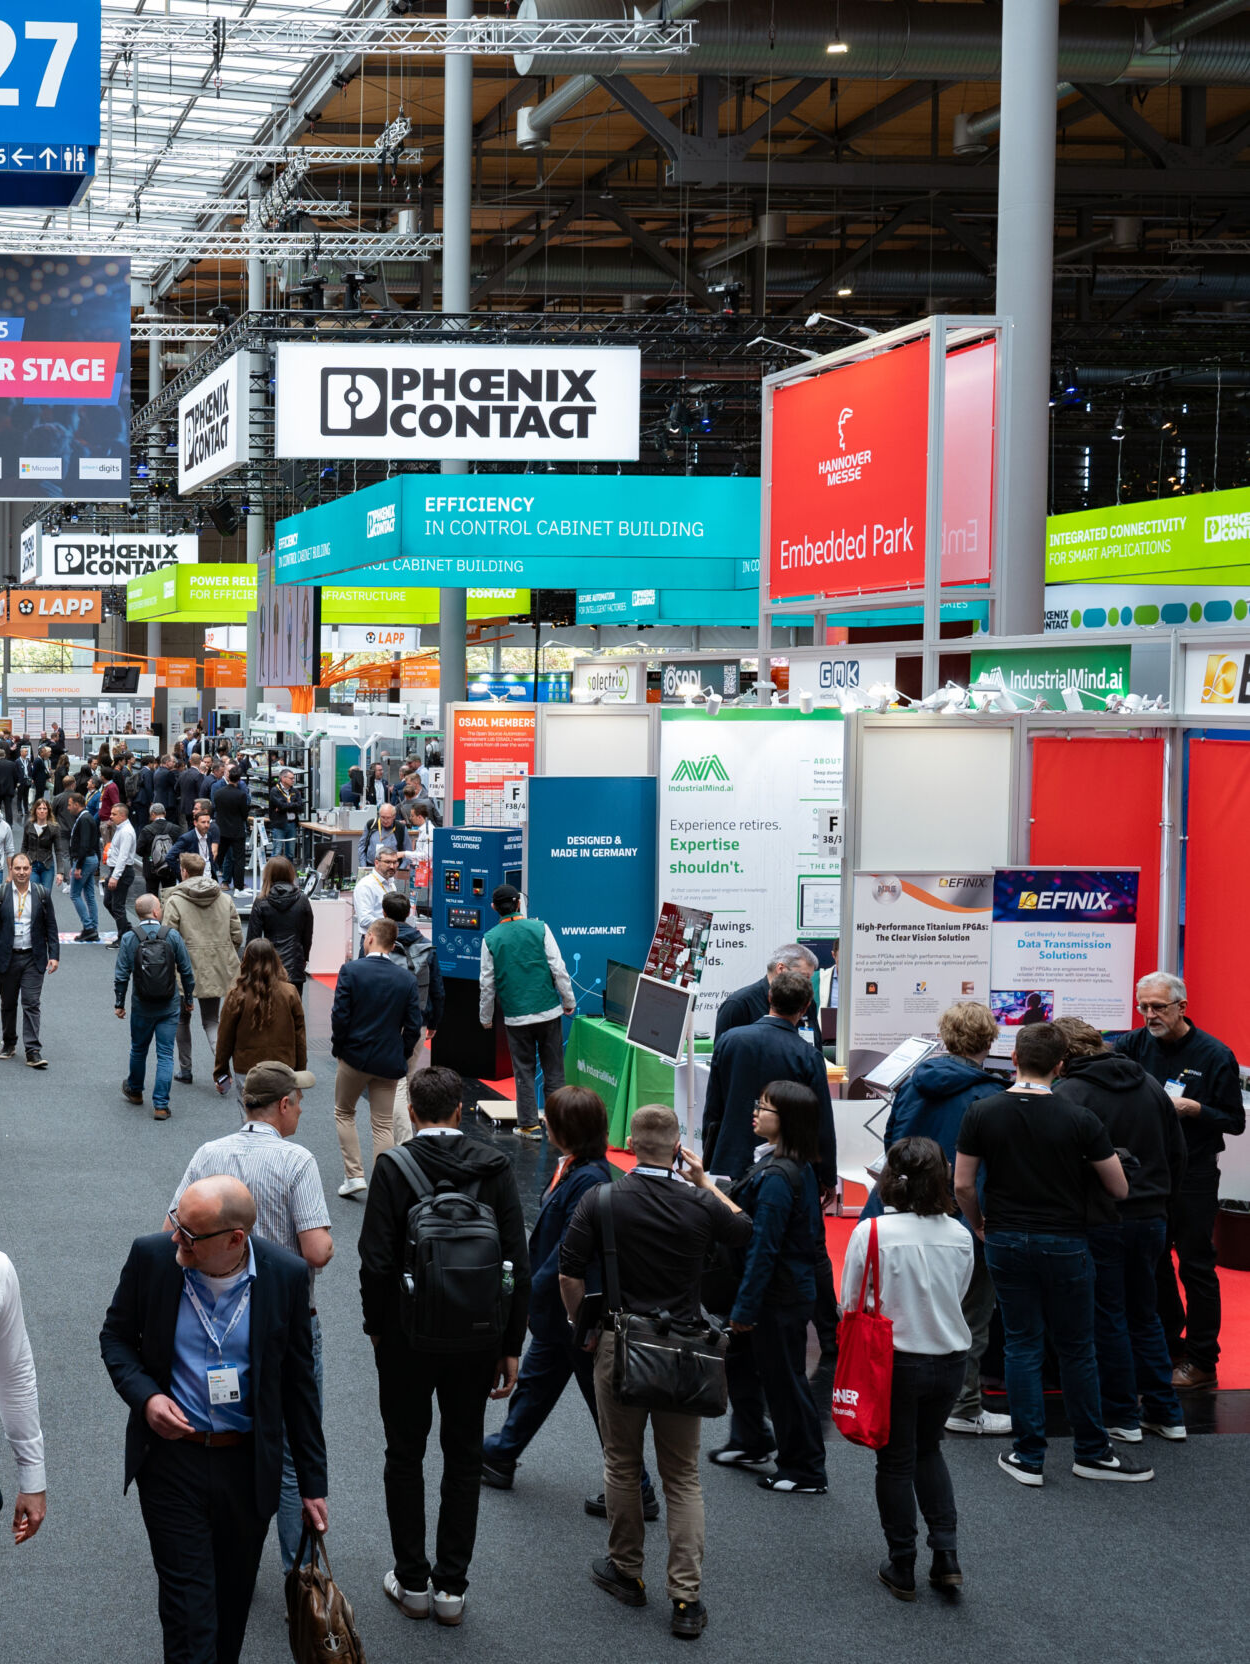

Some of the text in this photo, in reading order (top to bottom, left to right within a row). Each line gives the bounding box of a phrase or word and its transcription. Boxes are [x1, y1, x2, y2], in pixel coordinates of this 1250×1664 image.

[22, 358, 105, 382] STAGE
[389, 404, 596, 438] CONTACT
[194, 414, 229, 466] CONTACT
[98, 464, 120, 473] digits
[818, 450, 871, 475] HANNOVER
[827, 467, 862, 486] MESSE
[425, 497, 535, 512] EFFICIENCY
[373, 518, 395, 536] CONTACT
[425, 519, 704, 537] IN CONTROL CABINET BUILDING
[1049, 516, 1186, 547] INTEGRATED CONNECTIVITY
[1221, 526, 1250, 541] CON
[780, 516, 914, 570] Embedded Park
[1049, 539, 1171, 566] FOR SMART APPLICATIONS
[85, 560, 179, 576] CONTAC
[393, 559, 453, 571] CABINET
[456, 560, 524, 572] BUILDING
[190, 576, 229, 586] POWER
[190, 590, 210, 600] FOR
[38, 598, 94, 616] LAPP
[378, 632, 404, 644] LAPP
[588, 669, 624, 690] solectrix
[1010, 667, 1123, 690] IndustrialMind.ai
[458, 718, 535, 727] OSADL MEMBERS
[434, 773, 440, 782] F
[512, 788, 520, 800] F
[670, 819, 782, 833] Experience retires.
[829, 816, 838, 832] F
[452, 842, 480, 850] SOLUTIONS
[567, 836, 622, 845] DESIGNED &
[670, 837, 740, 854] Expertise
[551, 848, 638, 857] MADE IN GERMANY
[669, 860, 744, 873] shouldn't.
[561, 926, 627, 935] WWW.GMK.NET
[856, 923, 989, 932] High-Performance Titanium FPGAs:
[716, 939, 747, 948] Lines.
[1017, 939, 1112, 949] Data Transmission
[1039, 951, 1088, 960] Solutions
